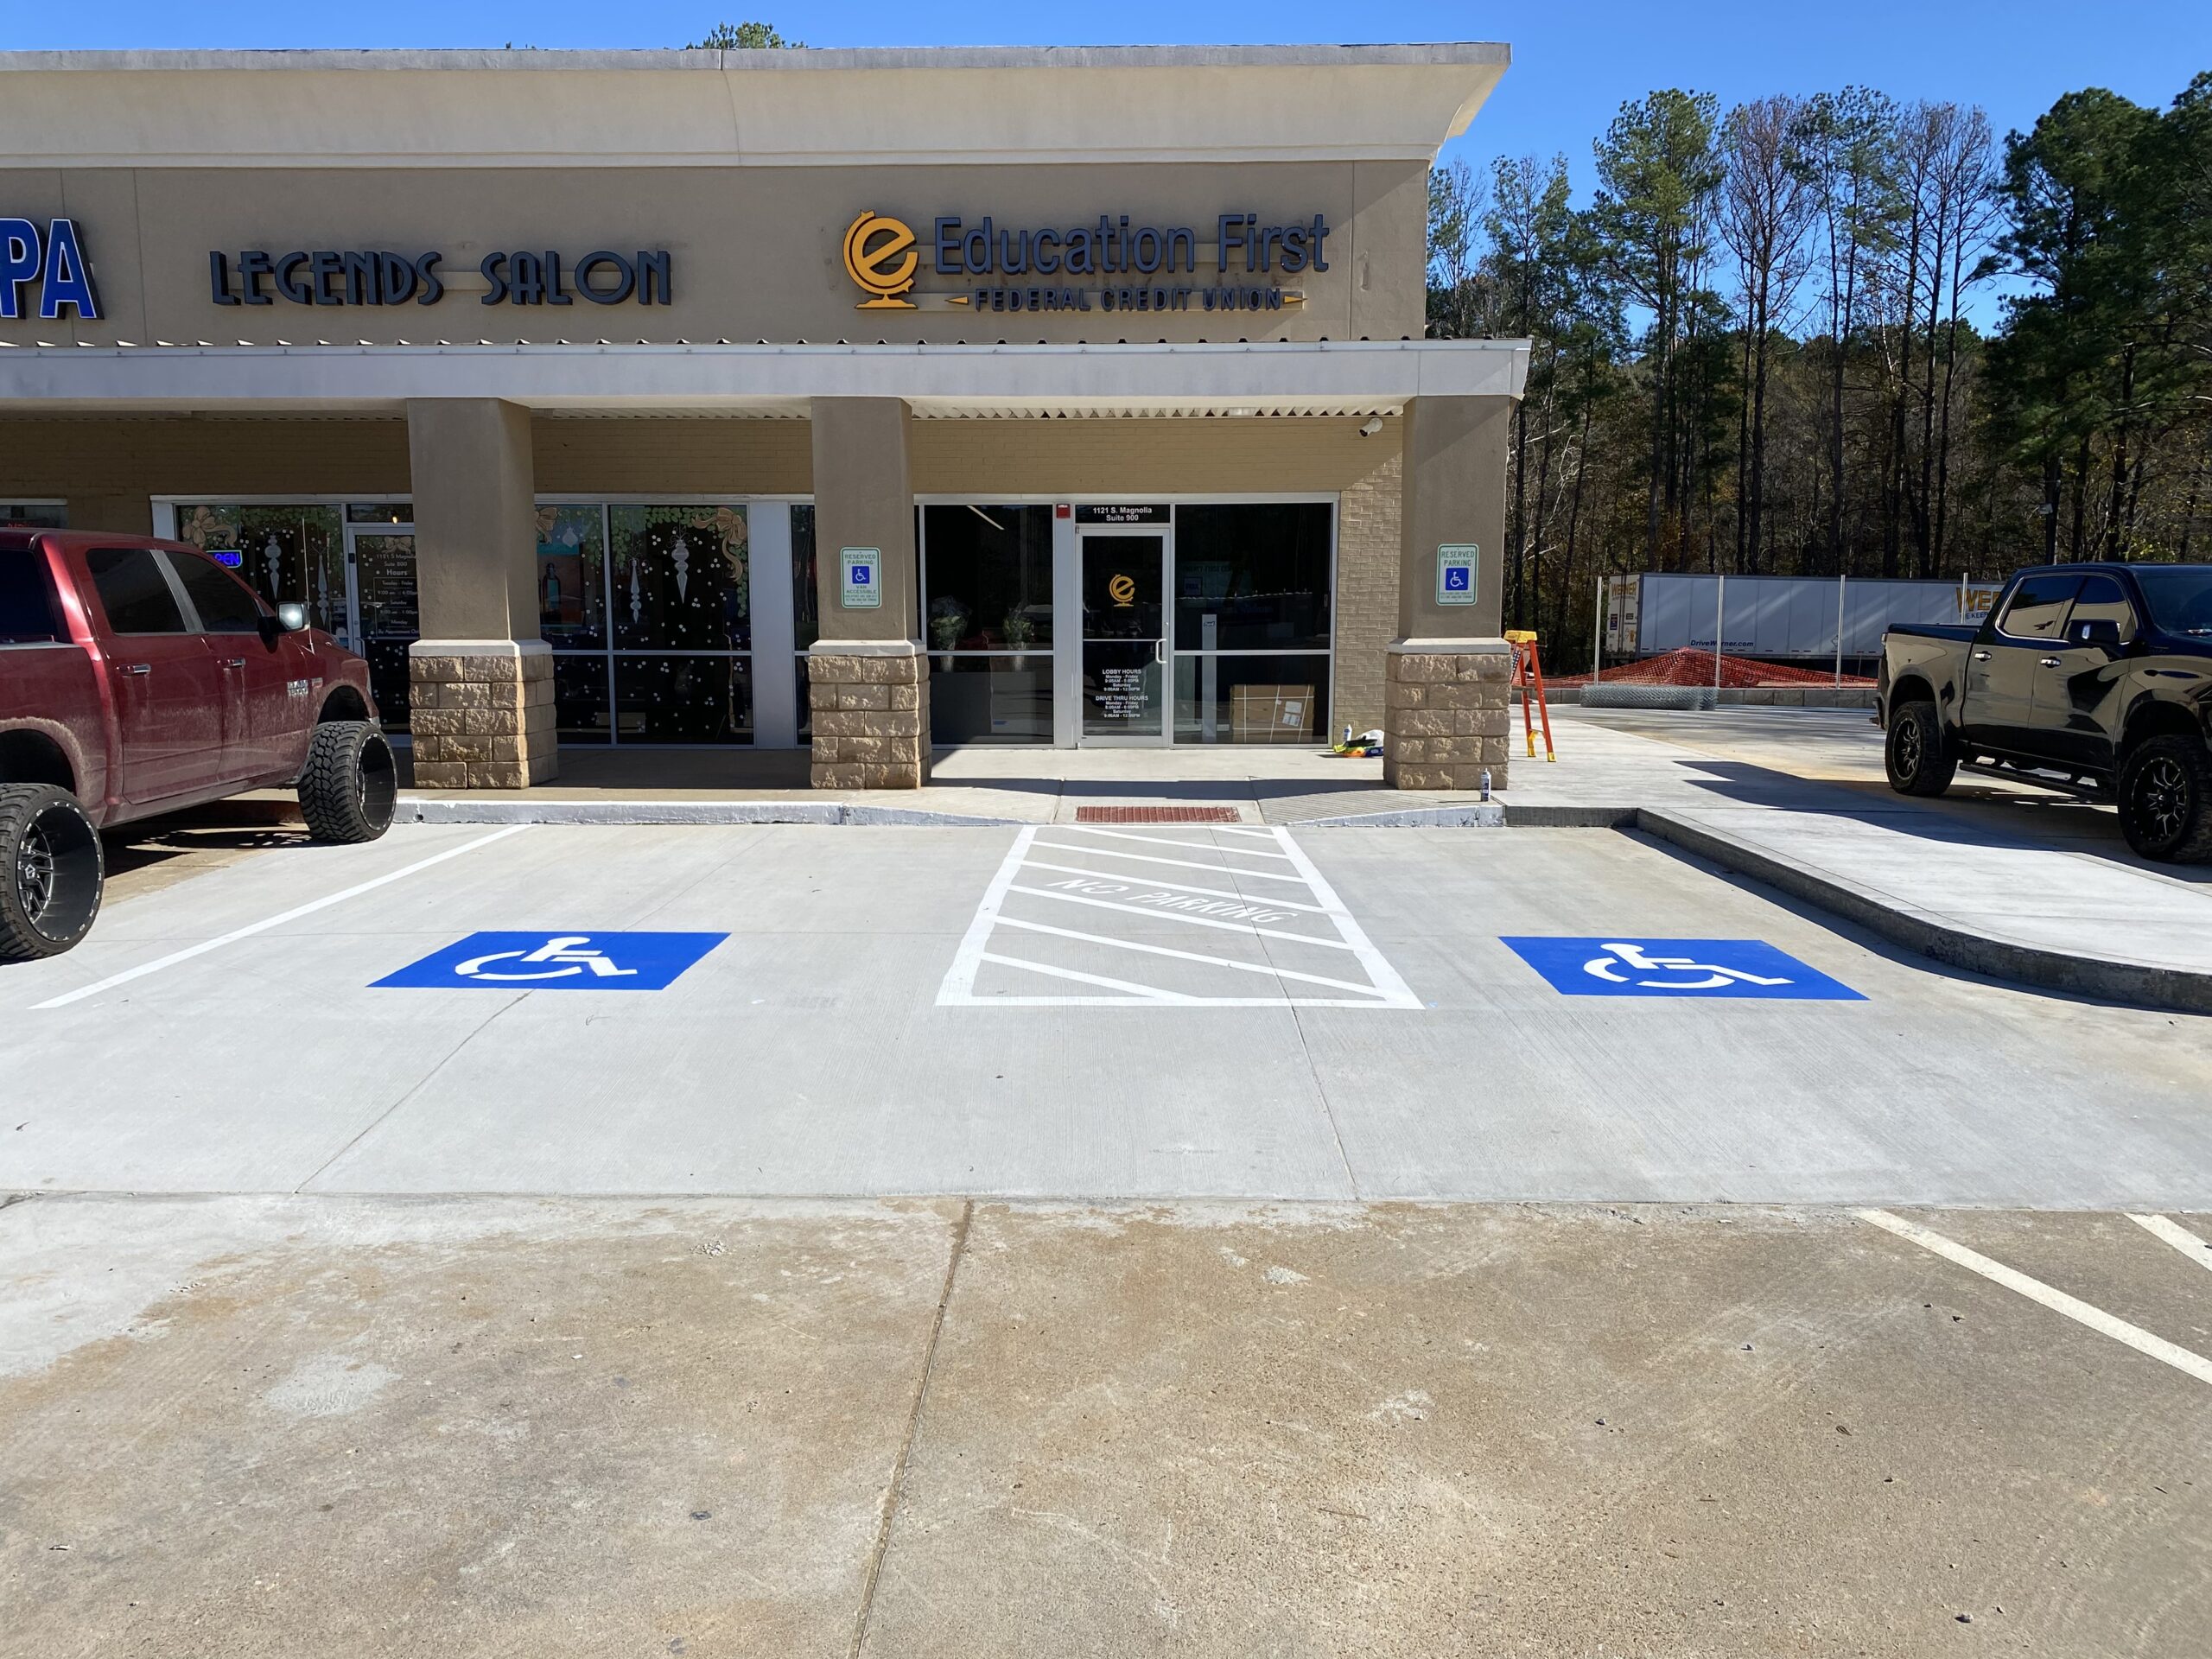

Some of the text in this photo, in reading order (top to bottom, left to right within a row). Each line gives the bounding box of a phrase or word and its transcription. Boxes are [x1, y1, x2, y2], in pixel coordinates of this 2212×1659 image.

[935, 213, 1329, 276] Education First
[210, 251, 671, 305] LEGENDS SALON
[975, 288, 1281, 312] FEDERAL CREDIT UNION
[1120, 506, 1153, 515] Magnolia
[1044, 879, 1298, 923] NO PARKING
